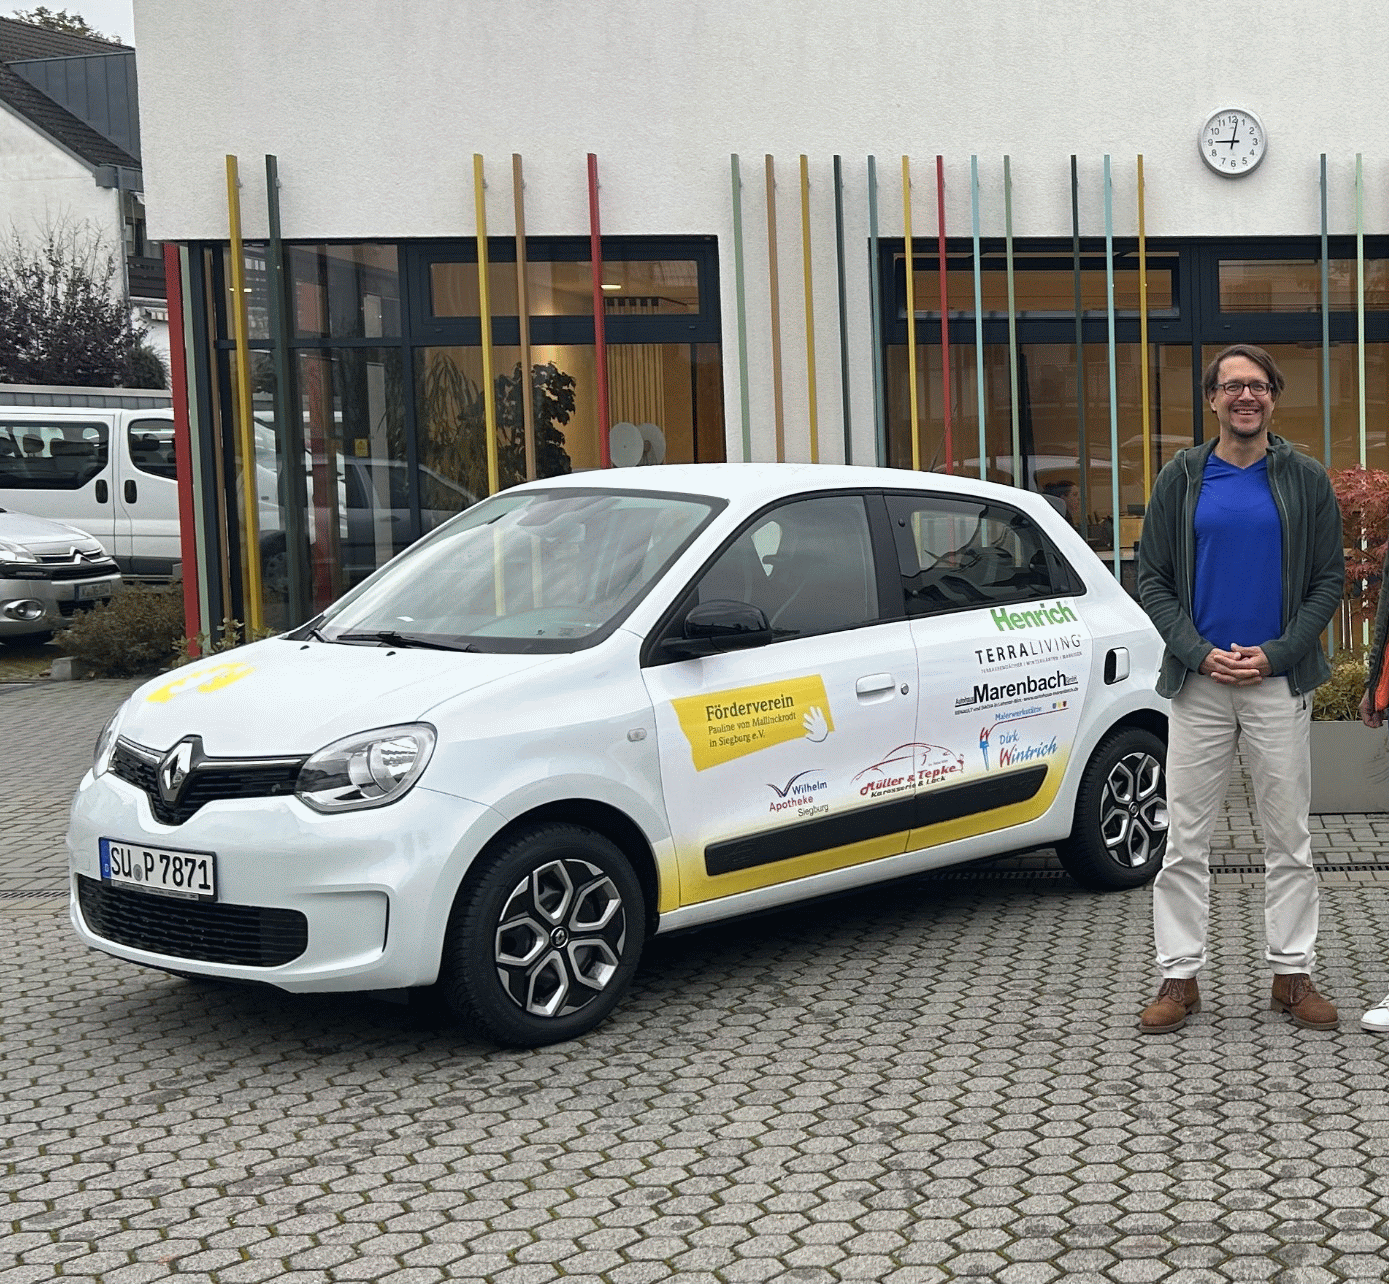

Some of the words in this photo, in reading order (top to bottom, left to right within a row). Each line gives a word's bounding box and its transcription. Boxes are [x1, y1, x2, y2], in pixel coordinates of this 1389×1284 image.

[1228, 116, 1238, 124] 12
[1208, 138, 1213, 146] 9
[1252, 138, 1258, 146] 3
[1211, 149, 1217, 157] 8
[990, 601, 1078, 632] Henrich
[973, 670, 1066, 703] Marenbach
[705, 694, 794, 722] Förderverein
[708, 722, 735, 735] Pauline
[737, 720, 750, 730] von
[752, 712, 796, 727] Mallinckrodt
[709, 738, 717, 748] in
[719, 733, 751, 746] Siegburg
[1000, 730, 1019, 745] Dirk
[1000, 736, 1058, 768] Wintrich
[792, 781, 828, 795] Wilhelm
[860, 777, 904, 796] Müller
[918, 765, 956, 780] Tepke
[926, 776, 946, 785] Lack
[769, 795, 813, 812] Apotheke
[798, 804, 829, 817] Siegburg
[111, 847, 132, 878] SU
[143, 851, 155, 881] P
[159, 854, 211, 890] 7871
